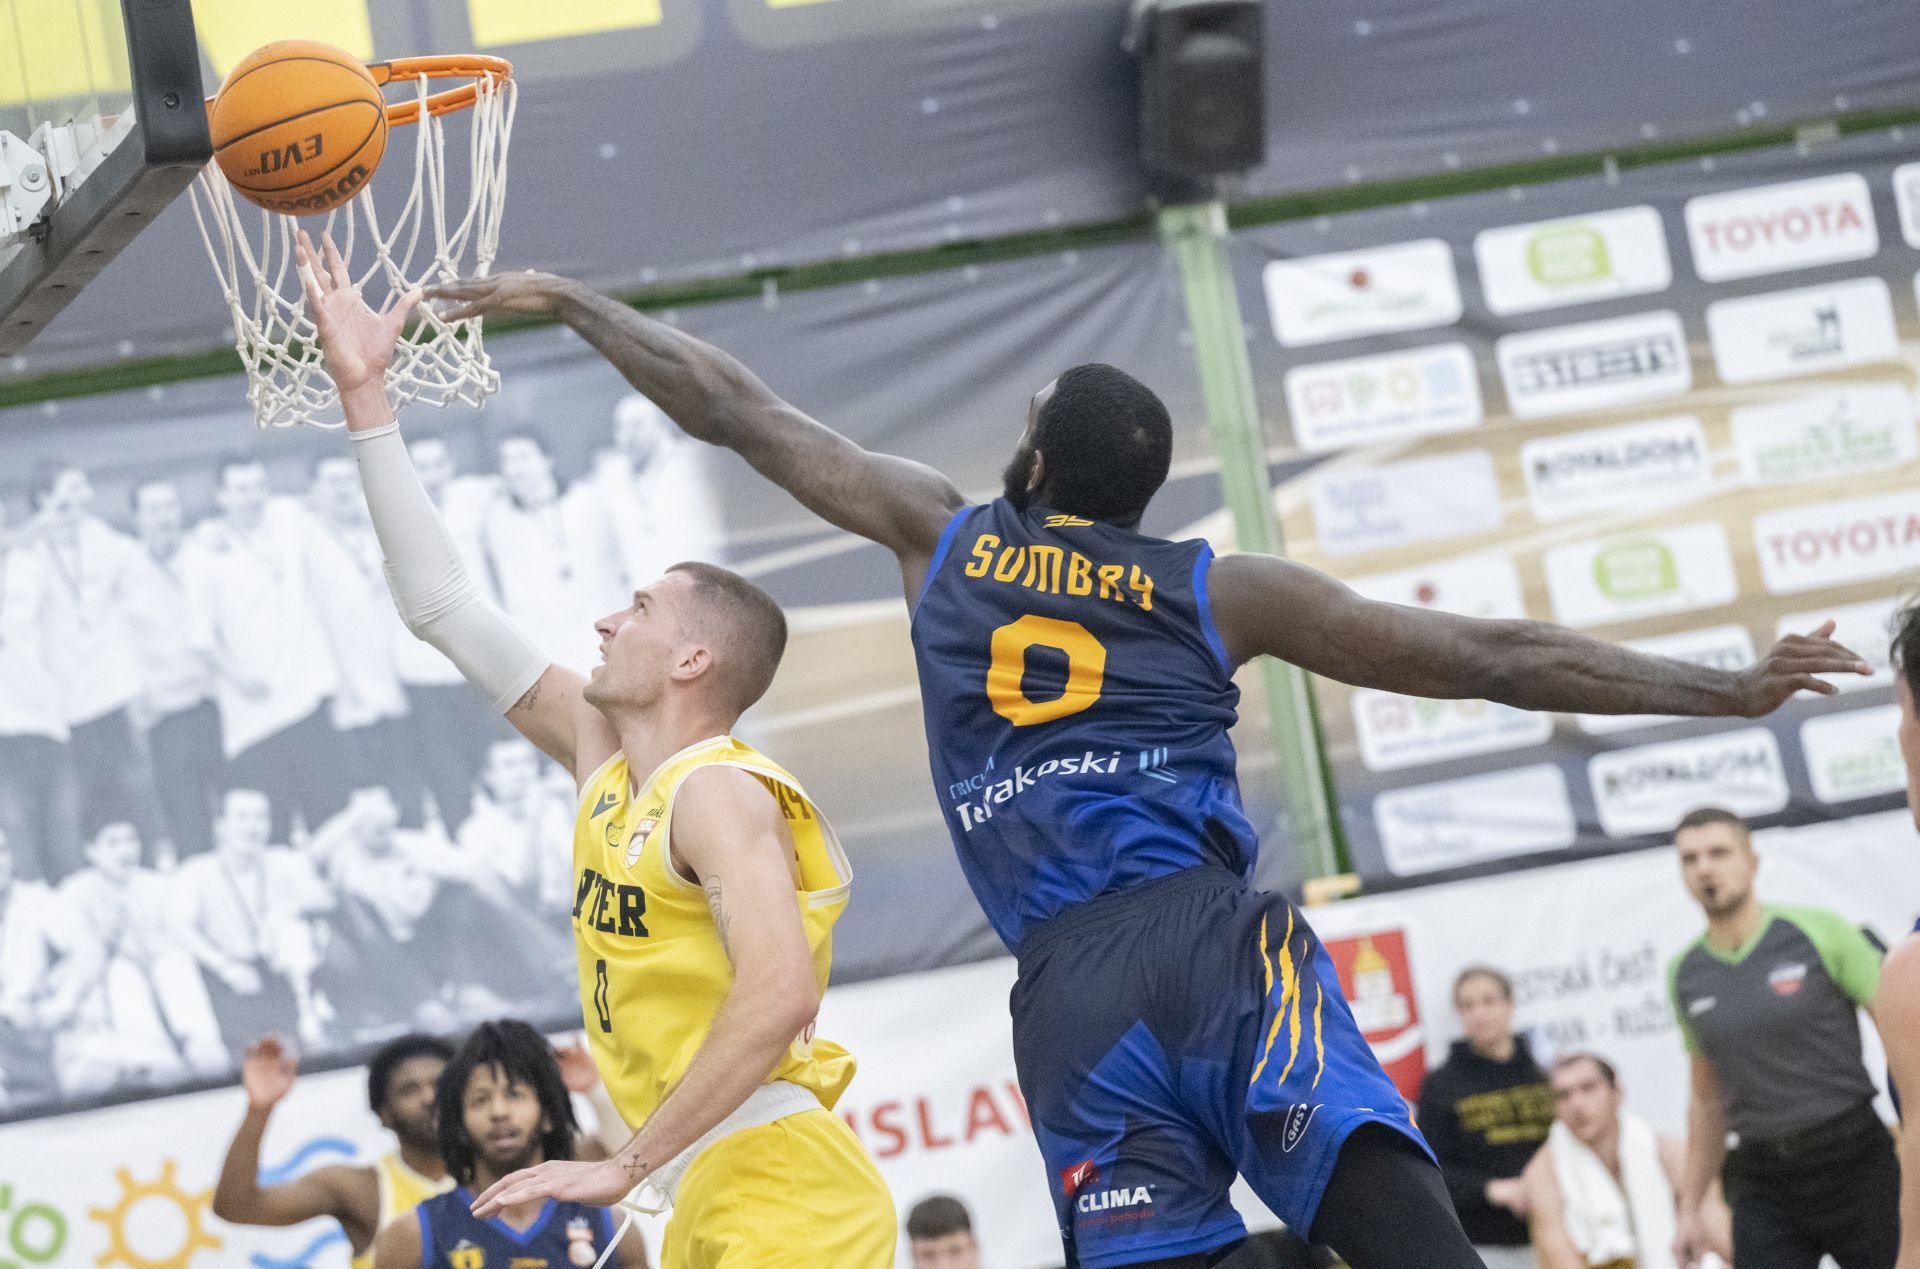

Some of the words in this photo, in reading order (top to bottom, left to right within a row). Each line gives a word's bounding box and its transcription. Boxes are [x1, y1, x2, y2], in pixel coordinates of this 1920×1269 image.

[260, 134, 322, 173] EVO
[1702, 201, 1863, 254] TOYOTA
[1766, 513, 1920, 569] TOYOTA
[965, 534, 1154, 612] SUMBRY
[986, 614, 1107, 727] 0
[594, 958, 613, 1034] 0
[1075, 1186, 1153, 1213] CLIMA
